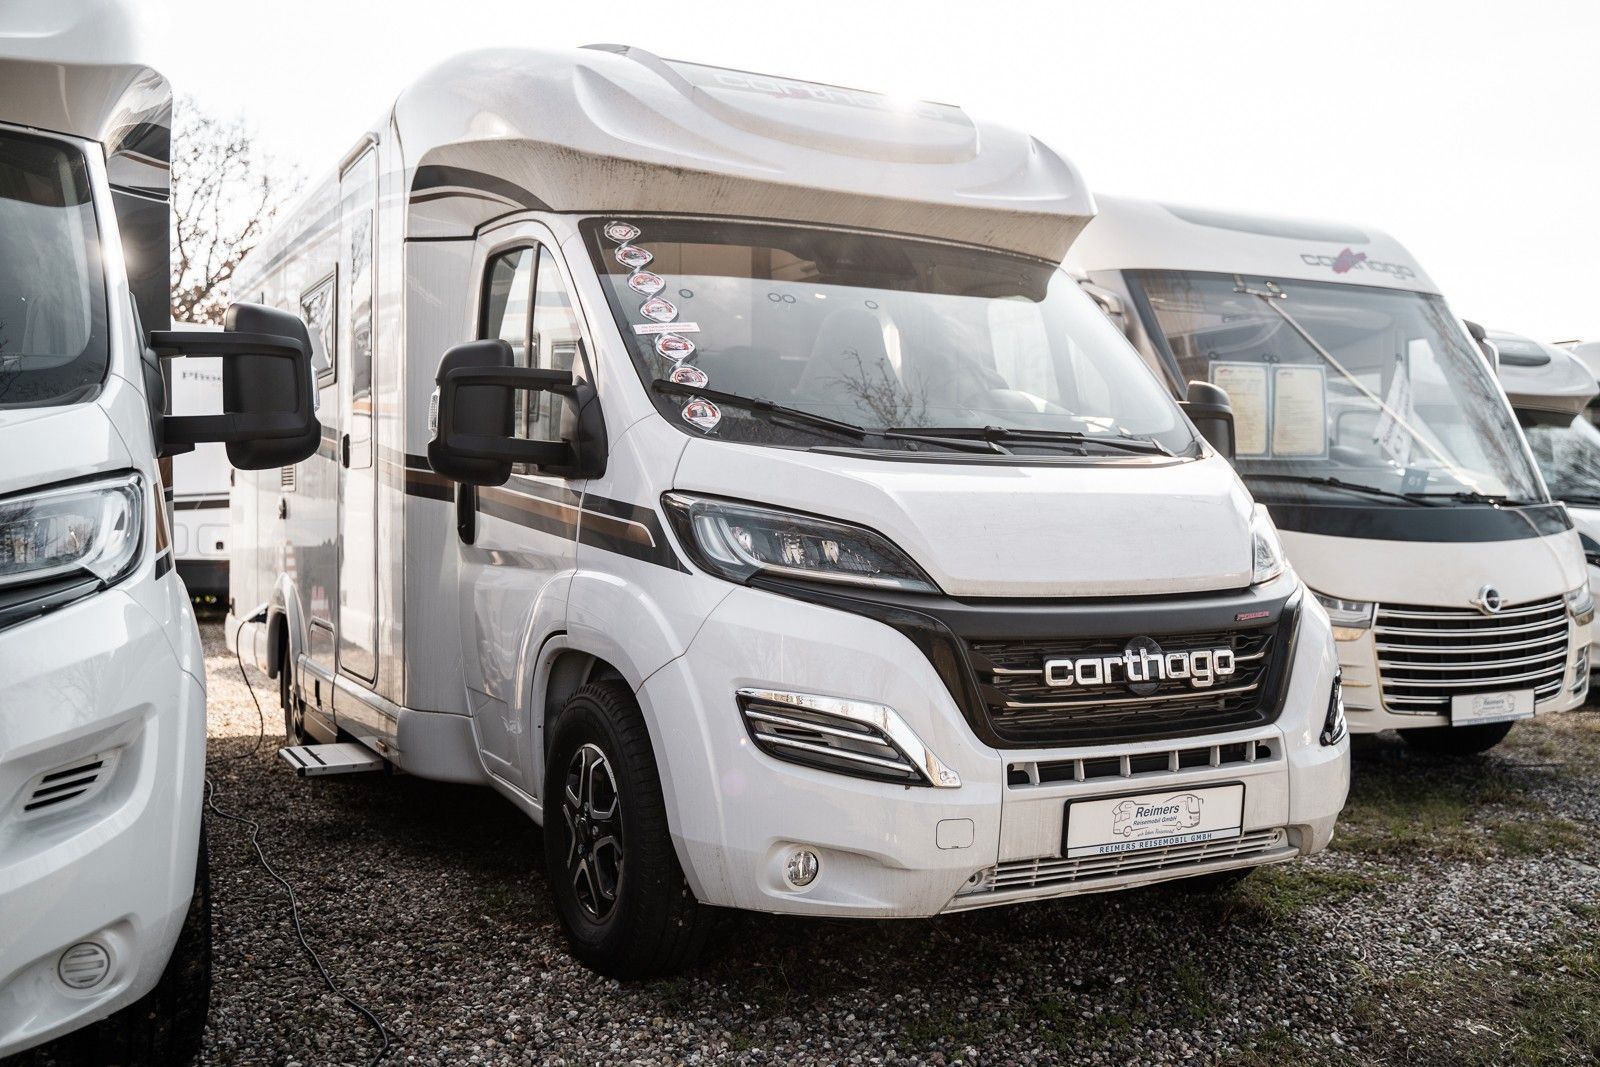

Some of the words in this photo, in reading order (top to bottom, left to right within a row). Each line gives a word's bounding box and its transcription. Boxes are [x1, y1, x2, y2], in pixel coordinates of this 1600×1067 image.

[1044, 648, 1236, 688] carthago
[1135, 805, 1180, 818] Reimers
[1132, 818, 1161, 826] Reisemobil
[1099, 843, 1136, 853] REIMERS
[1139, 836, 1188, 848] REISEMOBIL
[1190, 832, 1213, 842] GMBH
